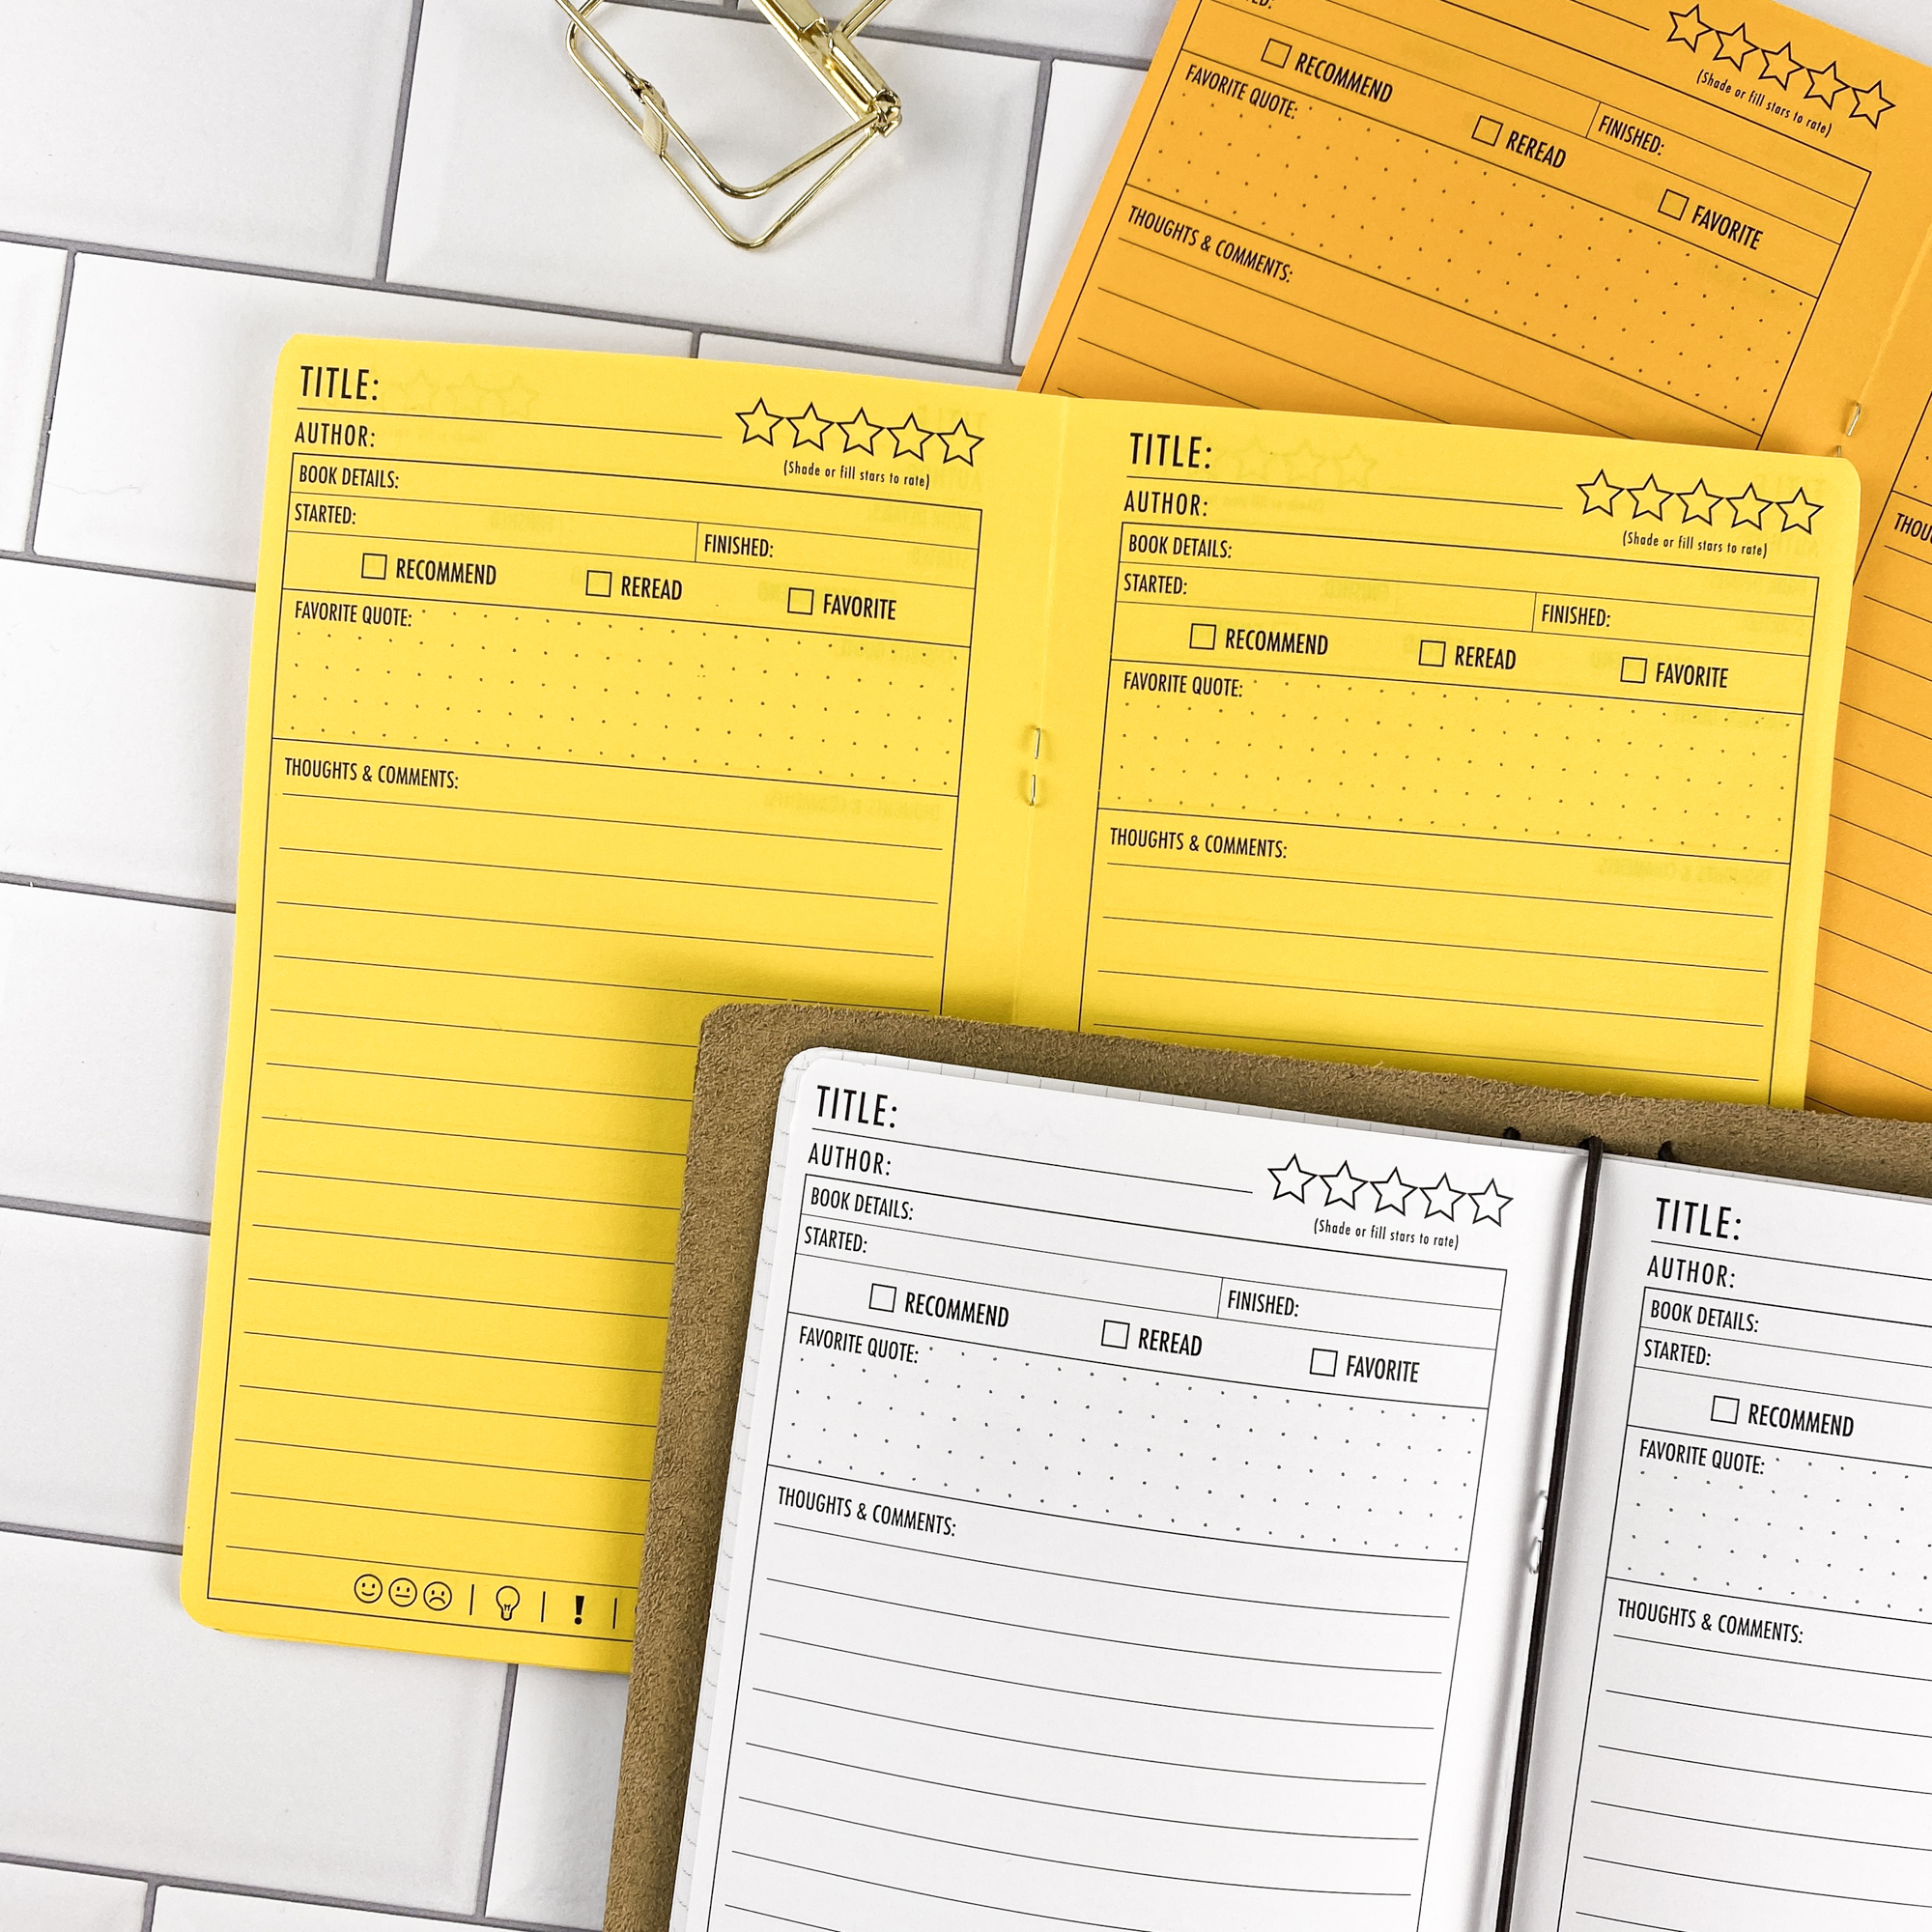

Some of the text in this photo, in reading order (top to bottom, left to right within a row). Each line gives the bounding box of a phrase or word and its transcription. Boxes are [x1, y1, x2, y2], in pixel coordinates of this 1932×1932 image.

[1184, 64, 1298, 120] FAVORITE QUOTE:
[1293, 51, 1394, 103] RECOMMEND
[1696, 69, 1833, 139] (Shade or fill stars to rate)
[1505, 129, 1567, 169] REREAD
[1598, 114, 1665, 156] FINISHED:
[1690, 204, 1764, 251] FAVORITE
[1127, 205, 1293, 283] THOUGHTS & COMMENTS:
[299, 365, 379, 401] TITLE:
[294, 421, 376, 448] AUTHOR:
[1129, 432, 1212, 469] TITLE:
[298, 464, 399, 490] BOOK DETAILS:
[783, 459, 821, 476] (Shade
[824, 468, 837, 478] or
[838, 465, 856, 480] fill
[860, 469, 885, 483] stars
[889, 472, 899, 484] to
[903, 473, 930, 491] rate)
[294, 502, 356, 526] STARTED:
[1123, 490, 1208, 517] AUTHOR:
[1622, 529, 1659, 547] (Shade
[1662, 538, 1674, 548] or
[1677, 535, 1694, 550] fill
[1697, 540, 1723, 553] stars
[1727, 542, 1737, 554] to
[1741, 542, 1768, 559] rate)
[1893, 512, 1932, 545] THOU
[704, 533, 774, 558] FINISHED:
[1128, 533, 1233, 559] BOOK DETAILS:
[395, 557, 497, 585] RECOMMEND
[1123, 573, 1188, 595] STARTED:
[620, 575, 683, 601] REREAD
[295, 600, 412, 627] FAVORITE QUOTE:
[823, 592, 897, 621] FAVORITE
[1541, 603, 1611, 628] FINISHED:
[1225, 628, 1329, 656] RECOMMEND
[1454, 644, 1517, 670] REREAD
[1123, 670, 1243, 697] FAVORITE QUOTE:
[1655, 662, 1729, 689] FAVORITE
[284, 756, 459, 790] THOUGHTS & COMMENTS:
[1110, 827, 1288, 859] THOUGHTS & COMMENTS:
[816, 1084, 897, 1129] TITLE:
[807, 1142, 892, 1177] AUTHOR:
[810, 1186, 914, 1221] BOOK DETAILS:
[1656, 1196, 1742, 1241] TITLE:
[804, 1225, 867, 1254] STARTED:
[1314, 1217, 1459, 1251] (Shade or fill stars to rate)
[1646, 1255, 1736, 1289] AUTHOR:
[904, 1291, 1009, 1328] RECOMMEND
[1227, 1290, 1299, 1318] FINISHED:
[1650, 1299, 1759, 1333] BOOK DETAILS:
[799, 1325, 920, 1364] FAVORITE QUOTE:
[1137, 1327, 1203, 1357] REREAD
[1643, 1338, 1712, 1367] STARTED:
[1346, 1354, 1421, 1383] FAVORITE
[1747, 1403, 1855, 1437] RECOMMEND
[1638, 1438, 1765, 1475] FAVORITE QUOTE:
[778, 1485, 956, 1538] THOUGHTS & COMMENTS:
[1617, 1598, 1804, 1644] THOUGHTS & COMMENTS:
